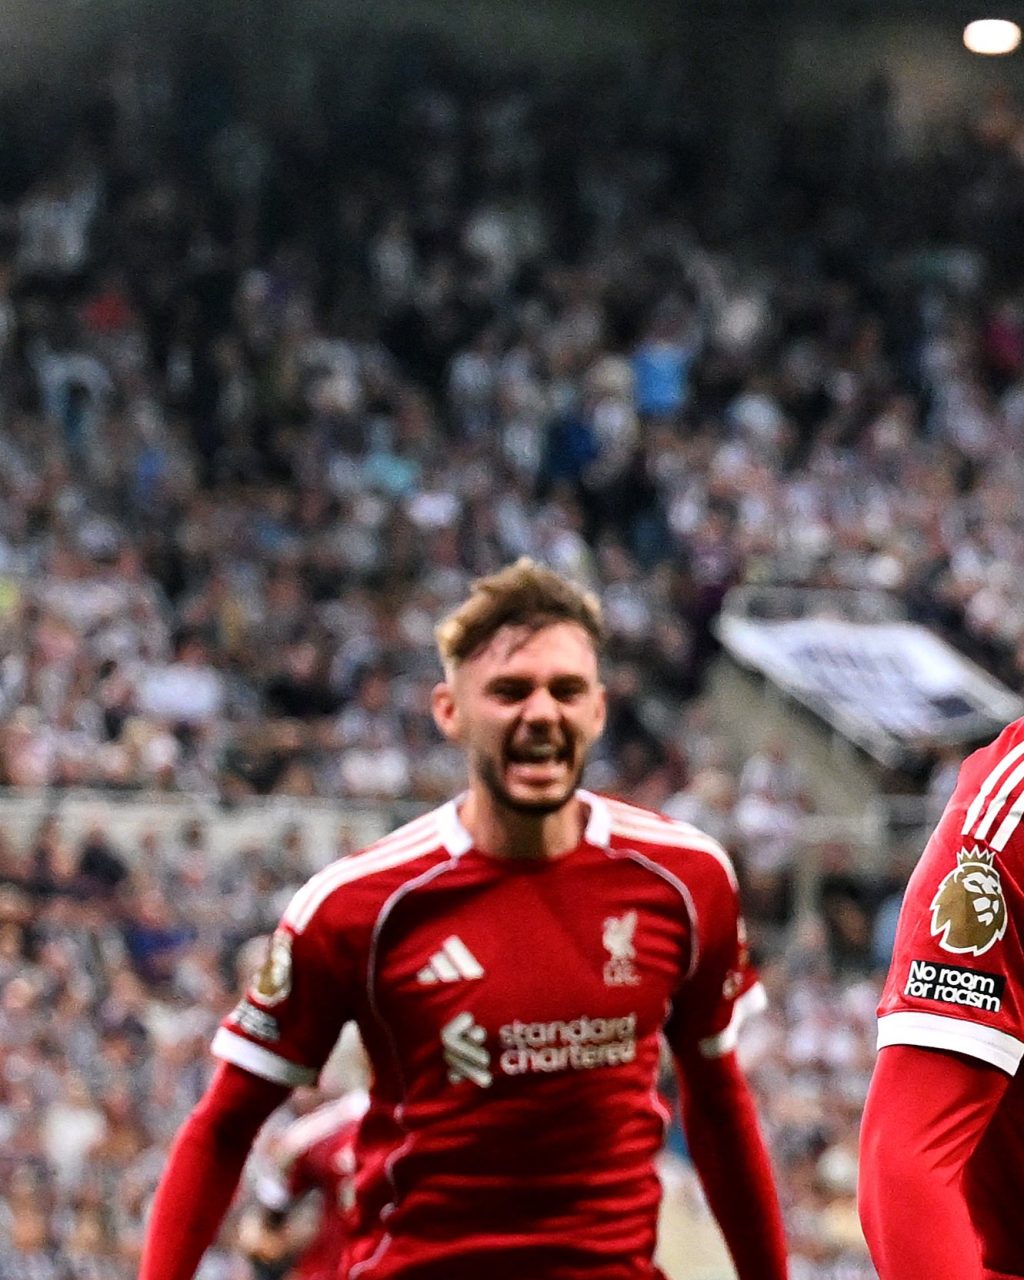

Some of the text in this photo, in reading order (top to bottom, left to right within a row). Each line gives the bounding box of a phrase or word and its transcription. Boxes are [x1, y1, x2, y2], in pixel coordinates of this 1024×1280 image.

[908, 961, 995, 993] No room
[904, 977, 1001, 1012] for racism
[499, 1012, 637, 1045] standard
